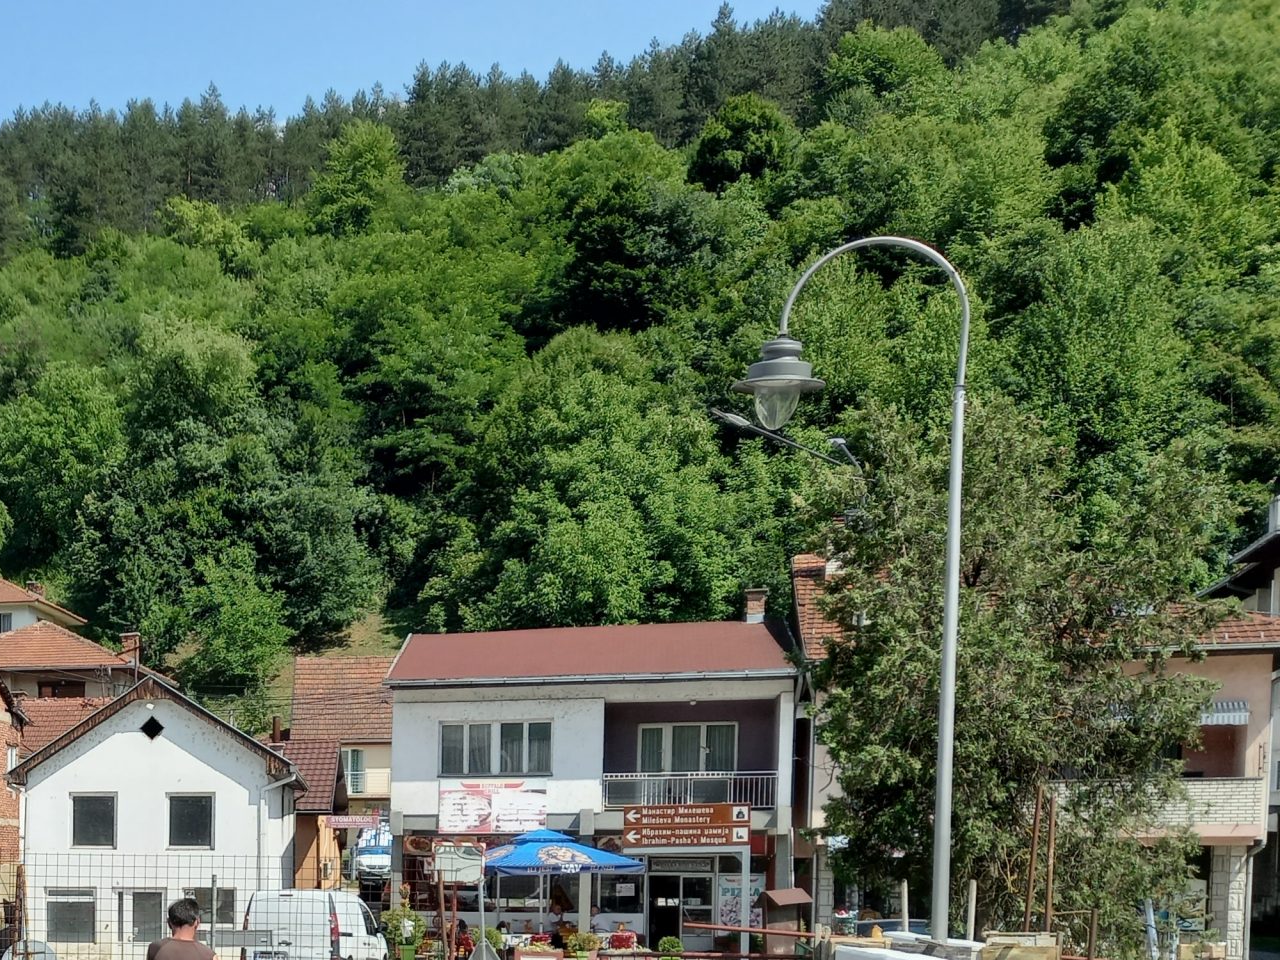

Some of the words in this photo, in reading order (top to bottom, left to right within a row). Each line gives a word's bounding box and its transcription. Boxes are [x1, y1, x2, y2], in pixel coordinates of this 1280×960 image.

[641, 807, 676, 816] Манастир
[678, 806, 714, 815] Милешева
[641, 815, 672, 824] Mileševa
[674, 815, 711, 825] Monastery
[641, 827, 701, 836] Ибрахим-пашина
[641, 836, 698, 845] Ibrahim-Pasha's
[700, 836, 727, 845] Mosque
[721, 887, 760, 897] PIZA
